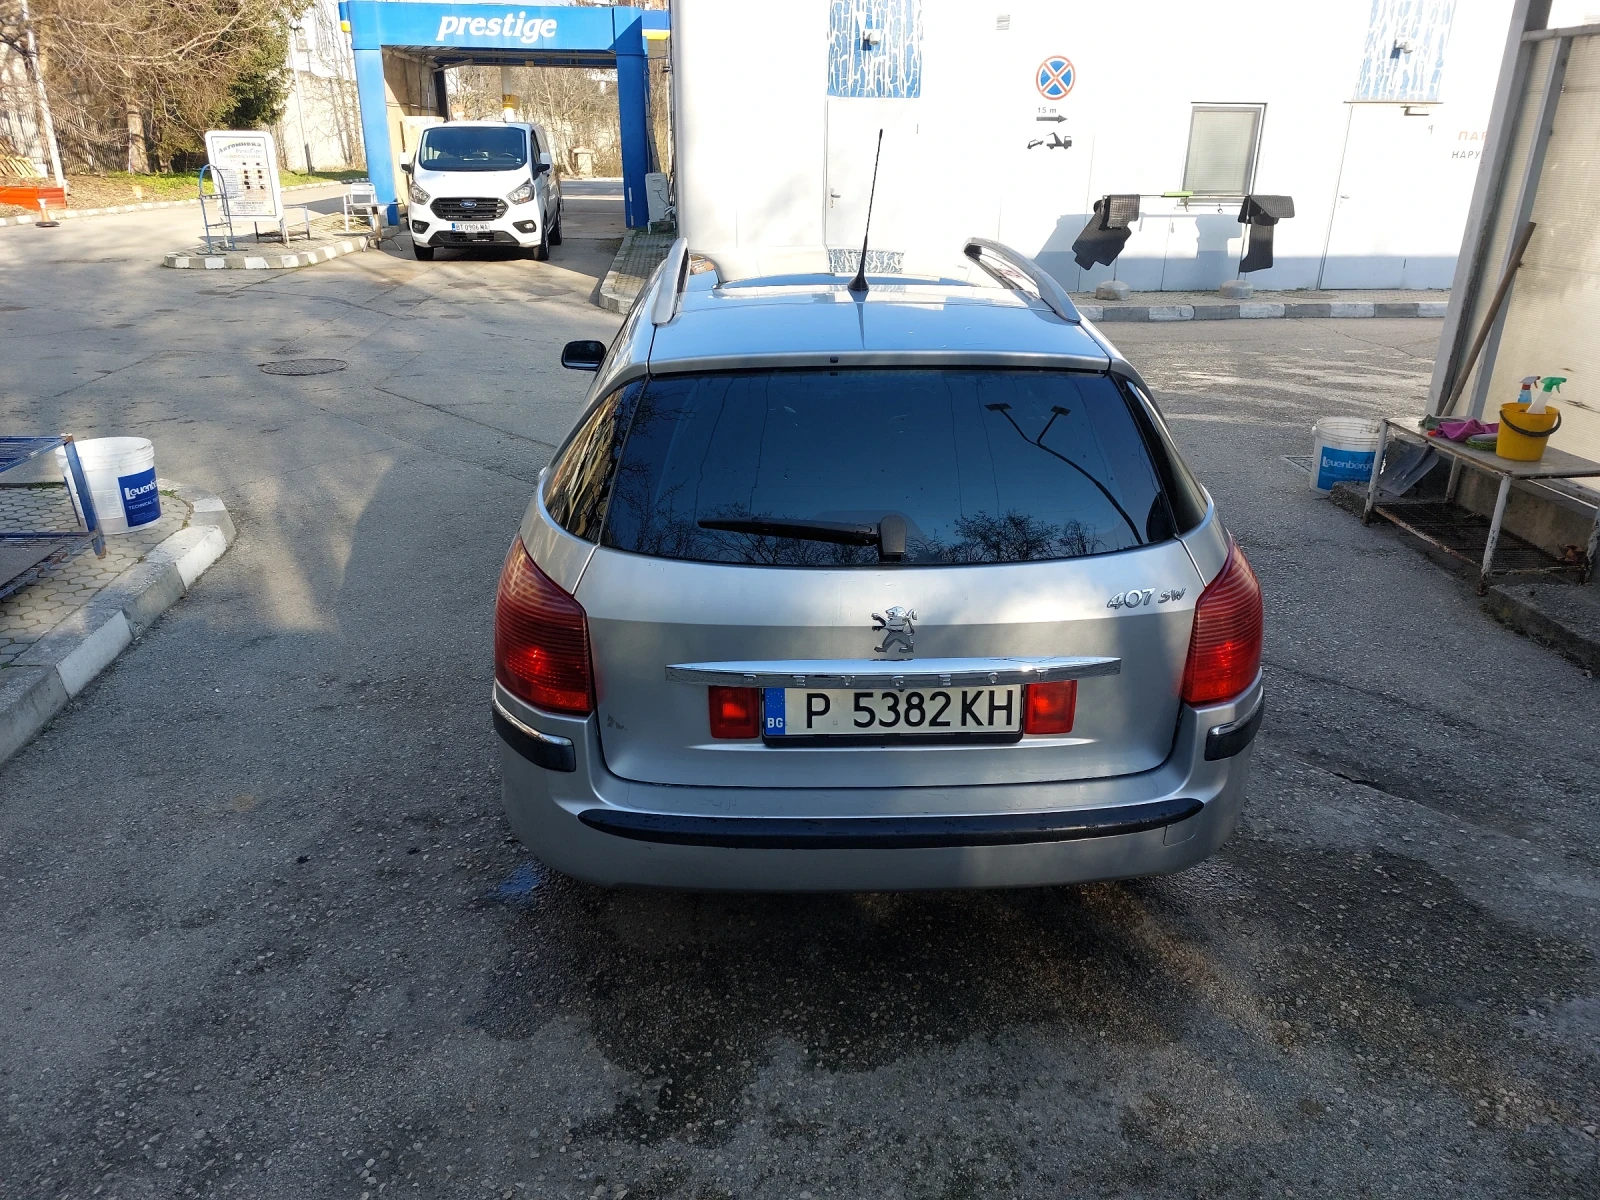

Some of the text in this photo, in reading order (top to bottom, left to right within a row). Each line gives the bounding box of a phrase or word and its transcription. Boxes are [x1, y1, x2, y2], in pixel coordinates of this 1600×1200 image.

[436, 11, 557, 44] prestige
[1106, 587, 1187, 609] 407 SW
[767, 717, 784, 729] BG
[806, 692, 831, 729] P
